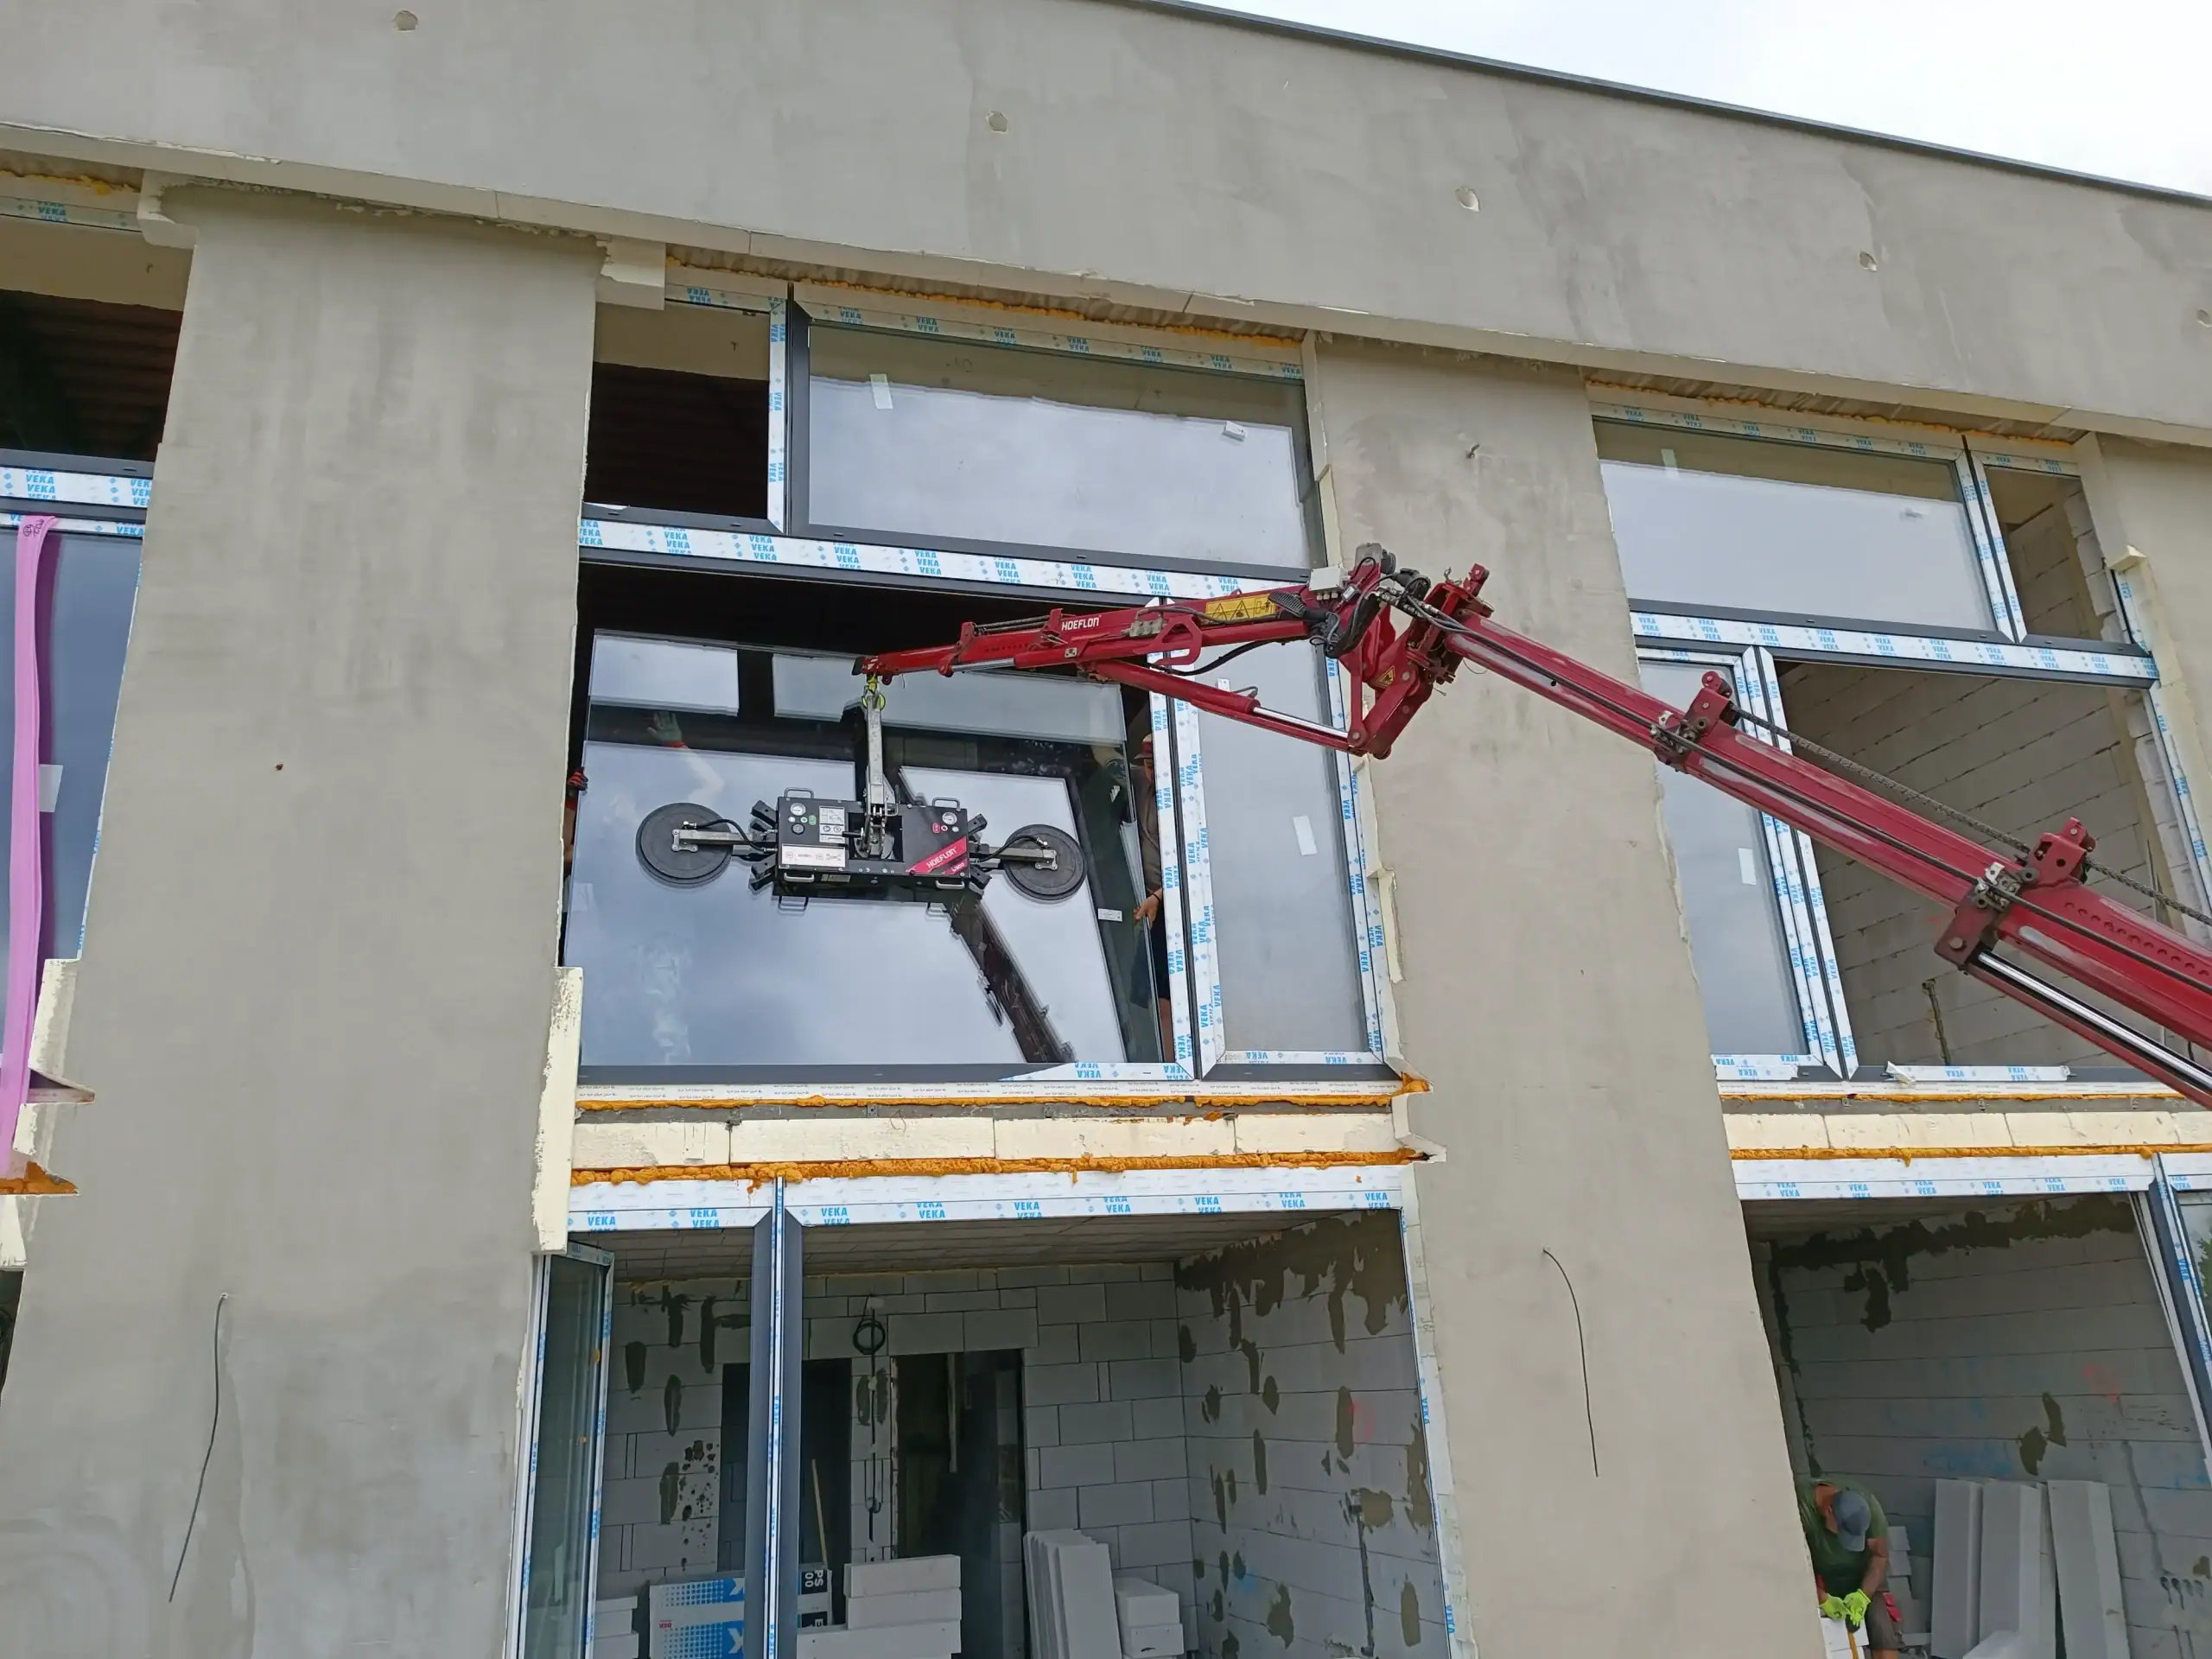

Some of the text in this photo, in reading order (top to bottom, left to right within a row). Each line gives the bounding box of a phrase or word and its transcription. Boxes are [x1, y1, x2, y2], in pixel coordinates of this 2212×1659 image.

[38, 207, 67, 216] VEKA
[840, 310, 861, 319] VEKA
[916, 316, 938, 325] VEKA
[995, 330, 1015, 339] VEKA
[768, 463, 777, 482] VEKA
[26, 474, 54, 484] VEKA
[28, 484, 55, 493] VEKA
[580, 520, 600, 529] EKA
[664, 531, 688, 540] VEKA
[749, 535, 772, 543] VEKA
[579, 537, 603, 546] VEKA
[666, 540, 690, 549] VEKA
[751, 543, 775, 552] VEKA
[834, 546, 857, 556] VEKA
[753, 552, 777, 561] VEKA
[914, 550, 938, 558] VEKA
[836, 555, 860, 563] VEKA
[917, 558, 939, 567] VEKA
[995, 561, 1017, 569] VEKA
[1071, 563, 1092, 572] VEKA
[919, 567, 942, 575] VEKA
[997, 569, 1020, 578] VEKA
[1073, 572, 1094, 581] VEKA
[1147, 574, 1167, 582] VEKA
[1217, 576, 1239, 585] VEKA
[1076, 580, 1097, 588] VEKA
[1149, 582, 1170, 591] VEKA
[1062, 617, 1100, 632] HOEFLON
[1154, 709, 1162, 731] VEKA
[926, 848, 957, 868] HOEFLON
[1164, 867, 1173, 889] VEKA
[1360, 950, 1369, 973] VEKA
[1790, 947, 1801, 968] VEKA
[1808, 957, 1819, 976] VEKA
[1213, 984, 1222, 1007] VEKA
[1199, 1004, 1208, 1027] VEKA
[1177, 1035, 1186, 1060] VEKA
[1076, 1069, 1102, 1078] VEKA
[1195, 1197, 1220, 1205] VEKA
[1364, 1192, 1388, 1201] VEKA
[1014, 1201, 1040, 1211] VEKA
[1281, 1199, 1306, 1208] VEKA
[690, 1208, 717, 1217] VEKA
[821, 1207, 848, 1217] VEKA
[1106, 1204, 1131, 1213] VEKA
[918, 1210, 946, 1219] VEKA
[588, 1217, 616, 1226] VEKA
[692, 1219, 720, 1229] VEKA
